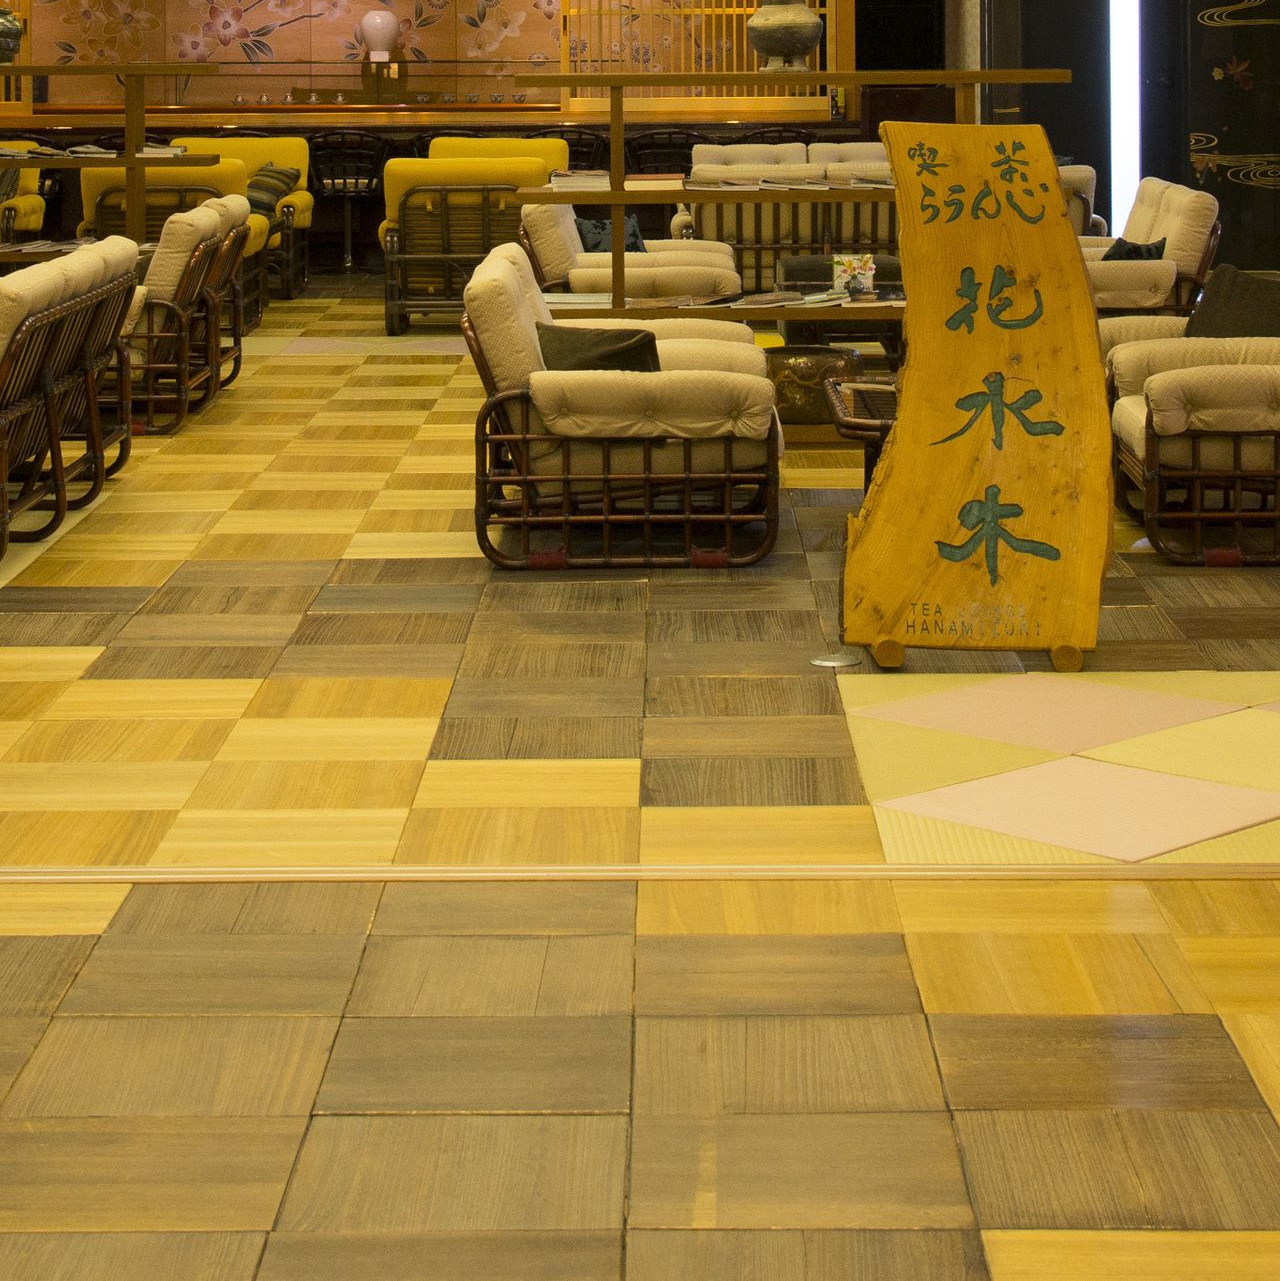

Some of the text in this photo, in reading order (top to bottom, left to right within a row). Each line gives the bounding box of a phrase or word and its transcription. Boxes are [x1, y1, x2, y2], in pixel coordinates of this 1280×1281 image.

[920, 181, 1049, 224] らうんじ
[929, 265, 1064, 586] 花水木
[910, 603, 942, 617] TEA
